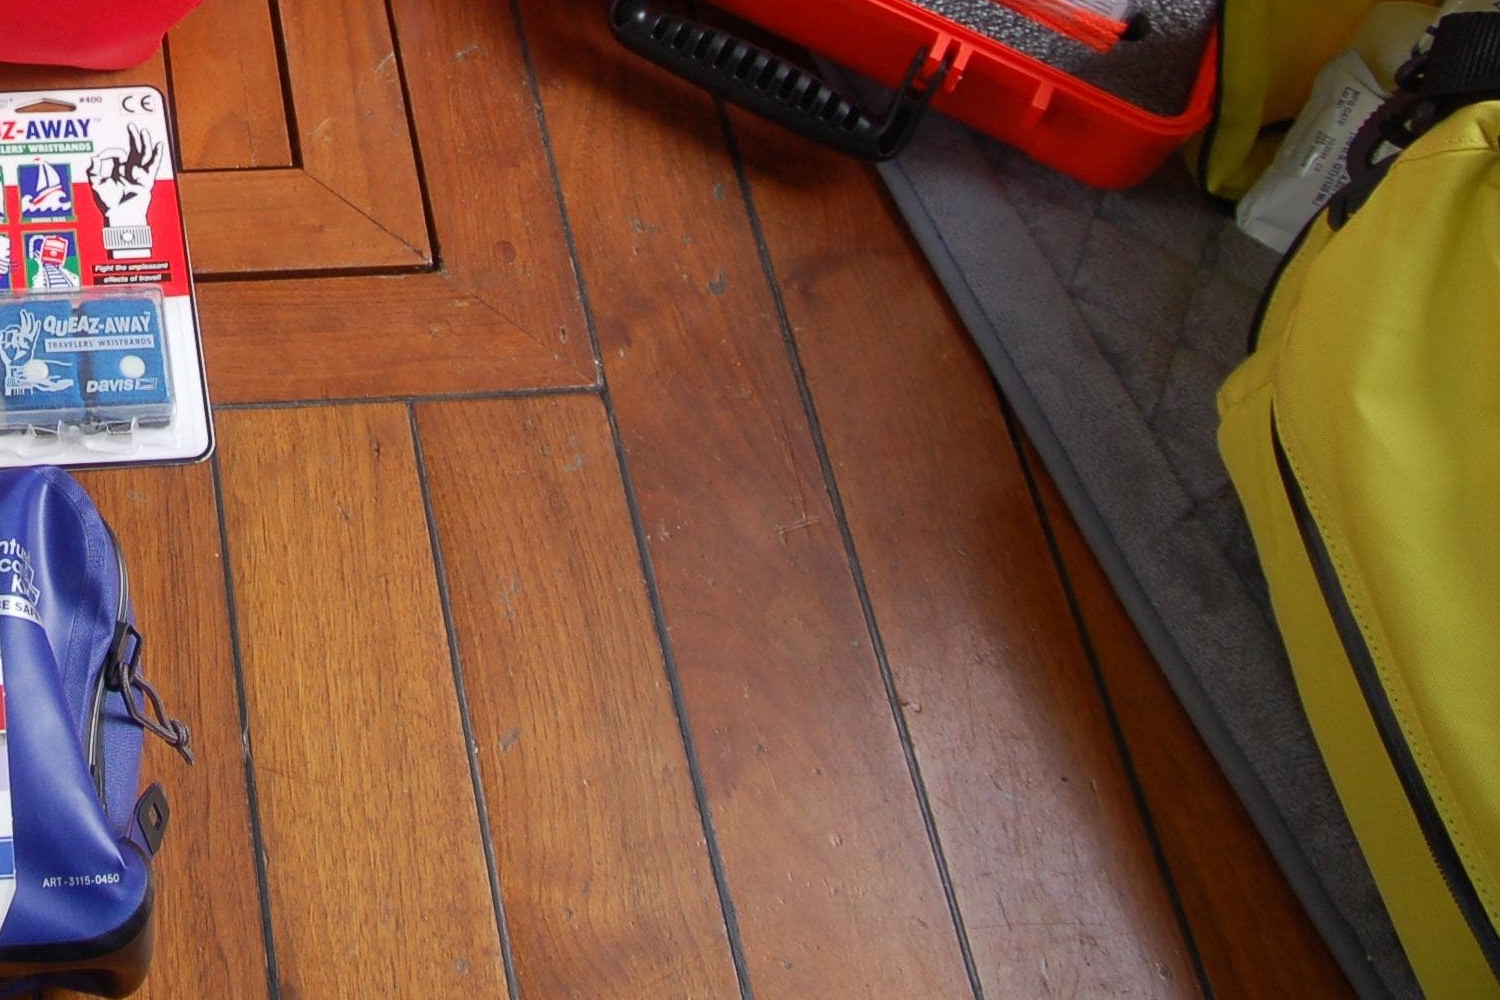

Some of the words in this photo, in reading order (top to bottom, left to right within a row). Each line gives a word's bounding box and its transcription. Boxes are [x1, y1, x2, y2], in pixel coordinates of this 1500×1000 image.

[28, 142, 92, 153] WRISTBANDS
[43, 314, 151, 336] QUEAZ-AWAY
[99, 337, 152, 347] WRISTBANDS
